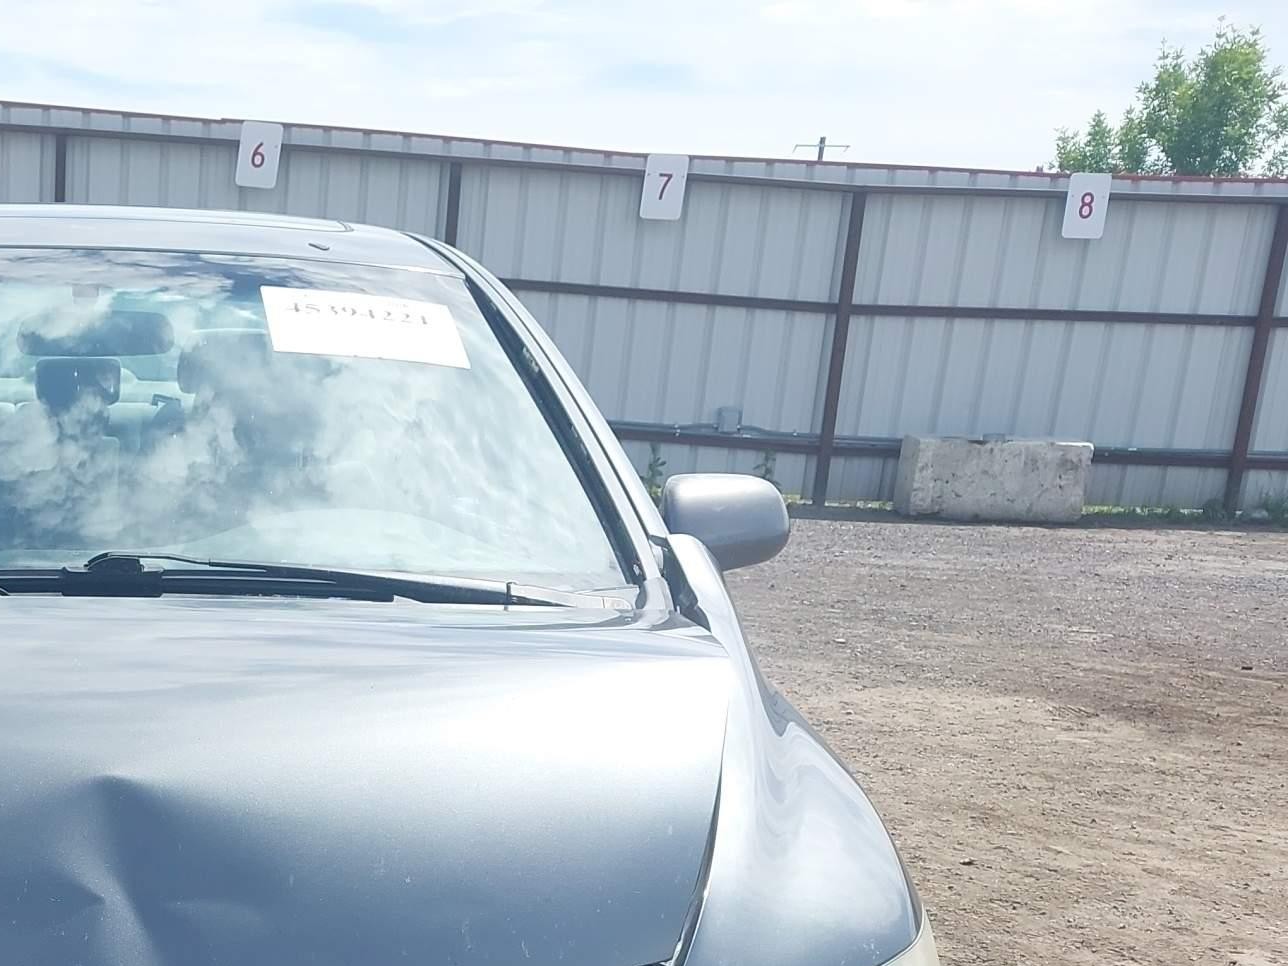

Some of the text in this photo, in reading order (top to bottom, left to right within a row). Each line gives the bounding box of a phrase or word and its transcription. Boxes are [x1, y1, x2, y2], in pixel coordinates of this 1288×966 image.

[251, 142, 265, 168] 6
[658, 173, 673, 201] 7
[1078, 191, 1095, 219] 8
